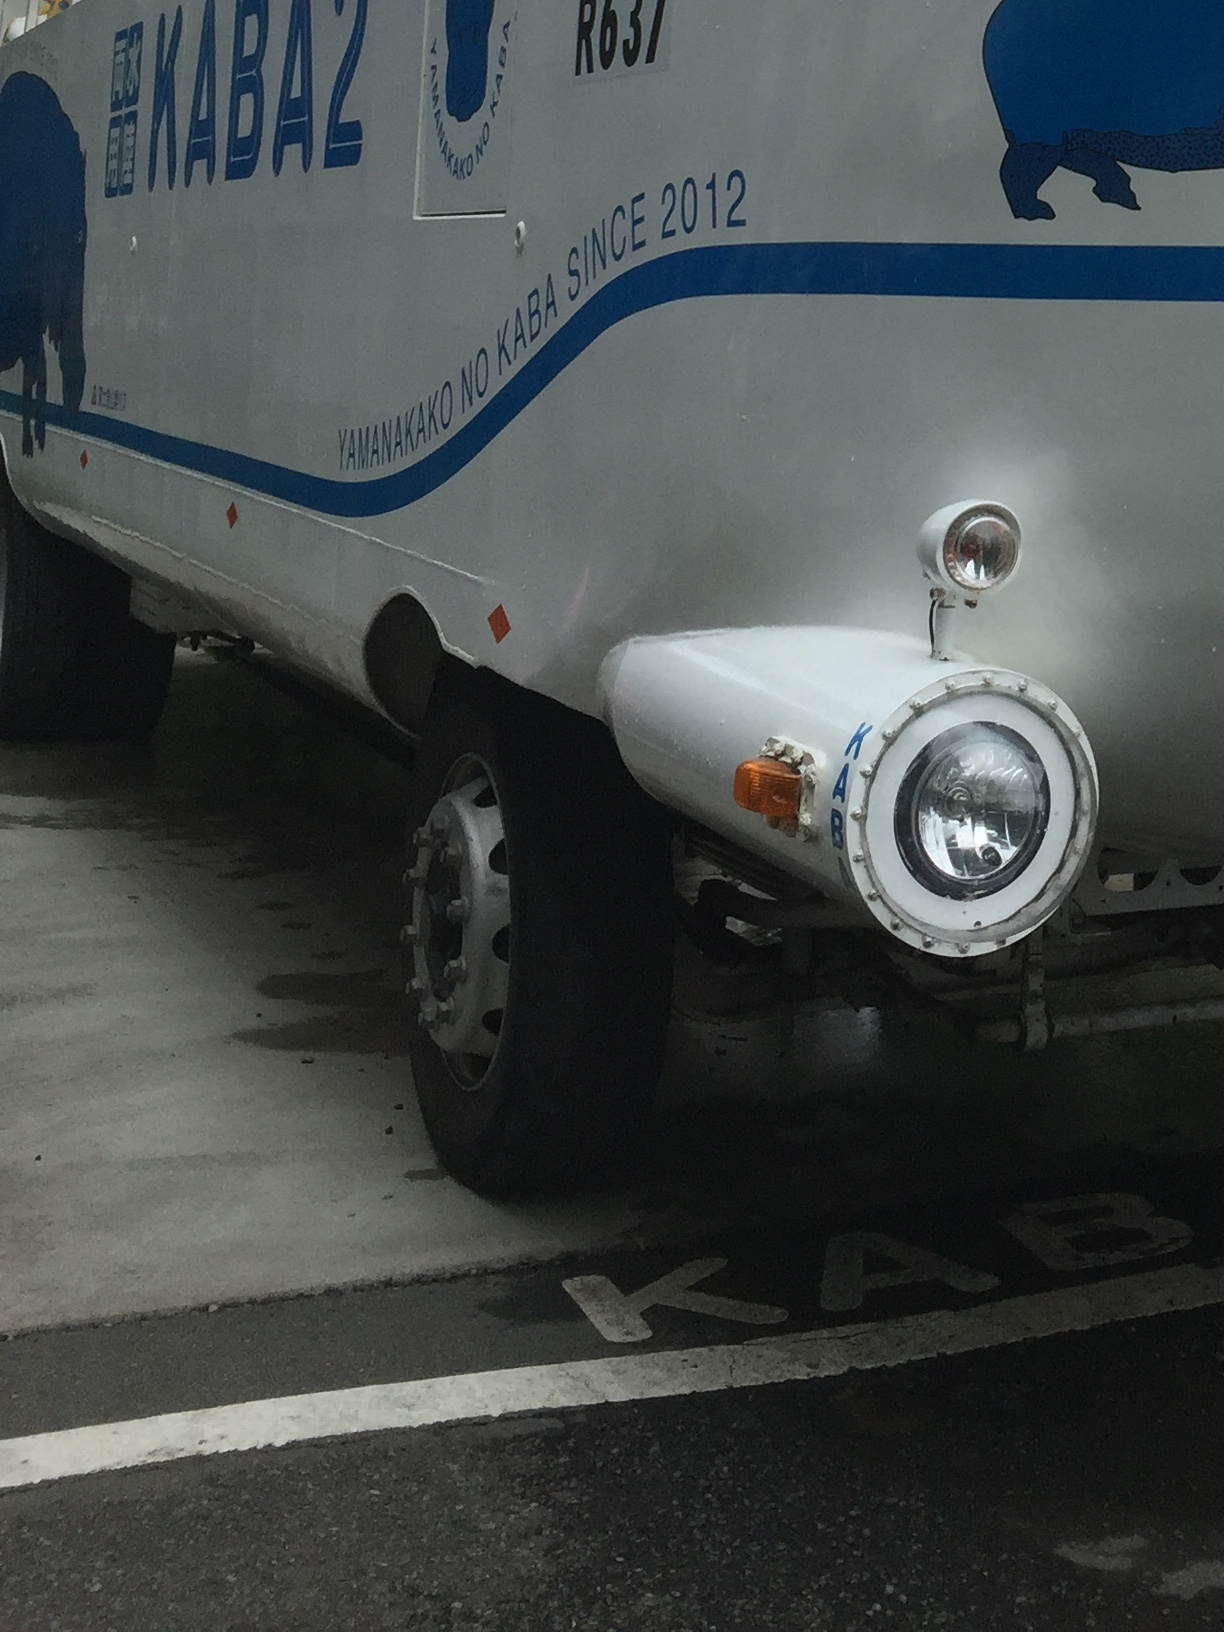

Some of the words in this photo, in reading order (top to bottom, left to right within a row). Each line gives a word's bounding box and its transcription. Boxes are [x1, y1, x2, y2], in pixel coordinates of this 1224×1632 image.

[475, 121, 490, 165] NO
[490, 20, 511, 119] KABA
[338, 380, 453, 471] YAMANAKAKO
[460, 347, 489, 413] NO
[496, 273, 559, 376] KABA
[567, 191, 647, 301] SINCE
[660, 169, 747, 240] 2012
